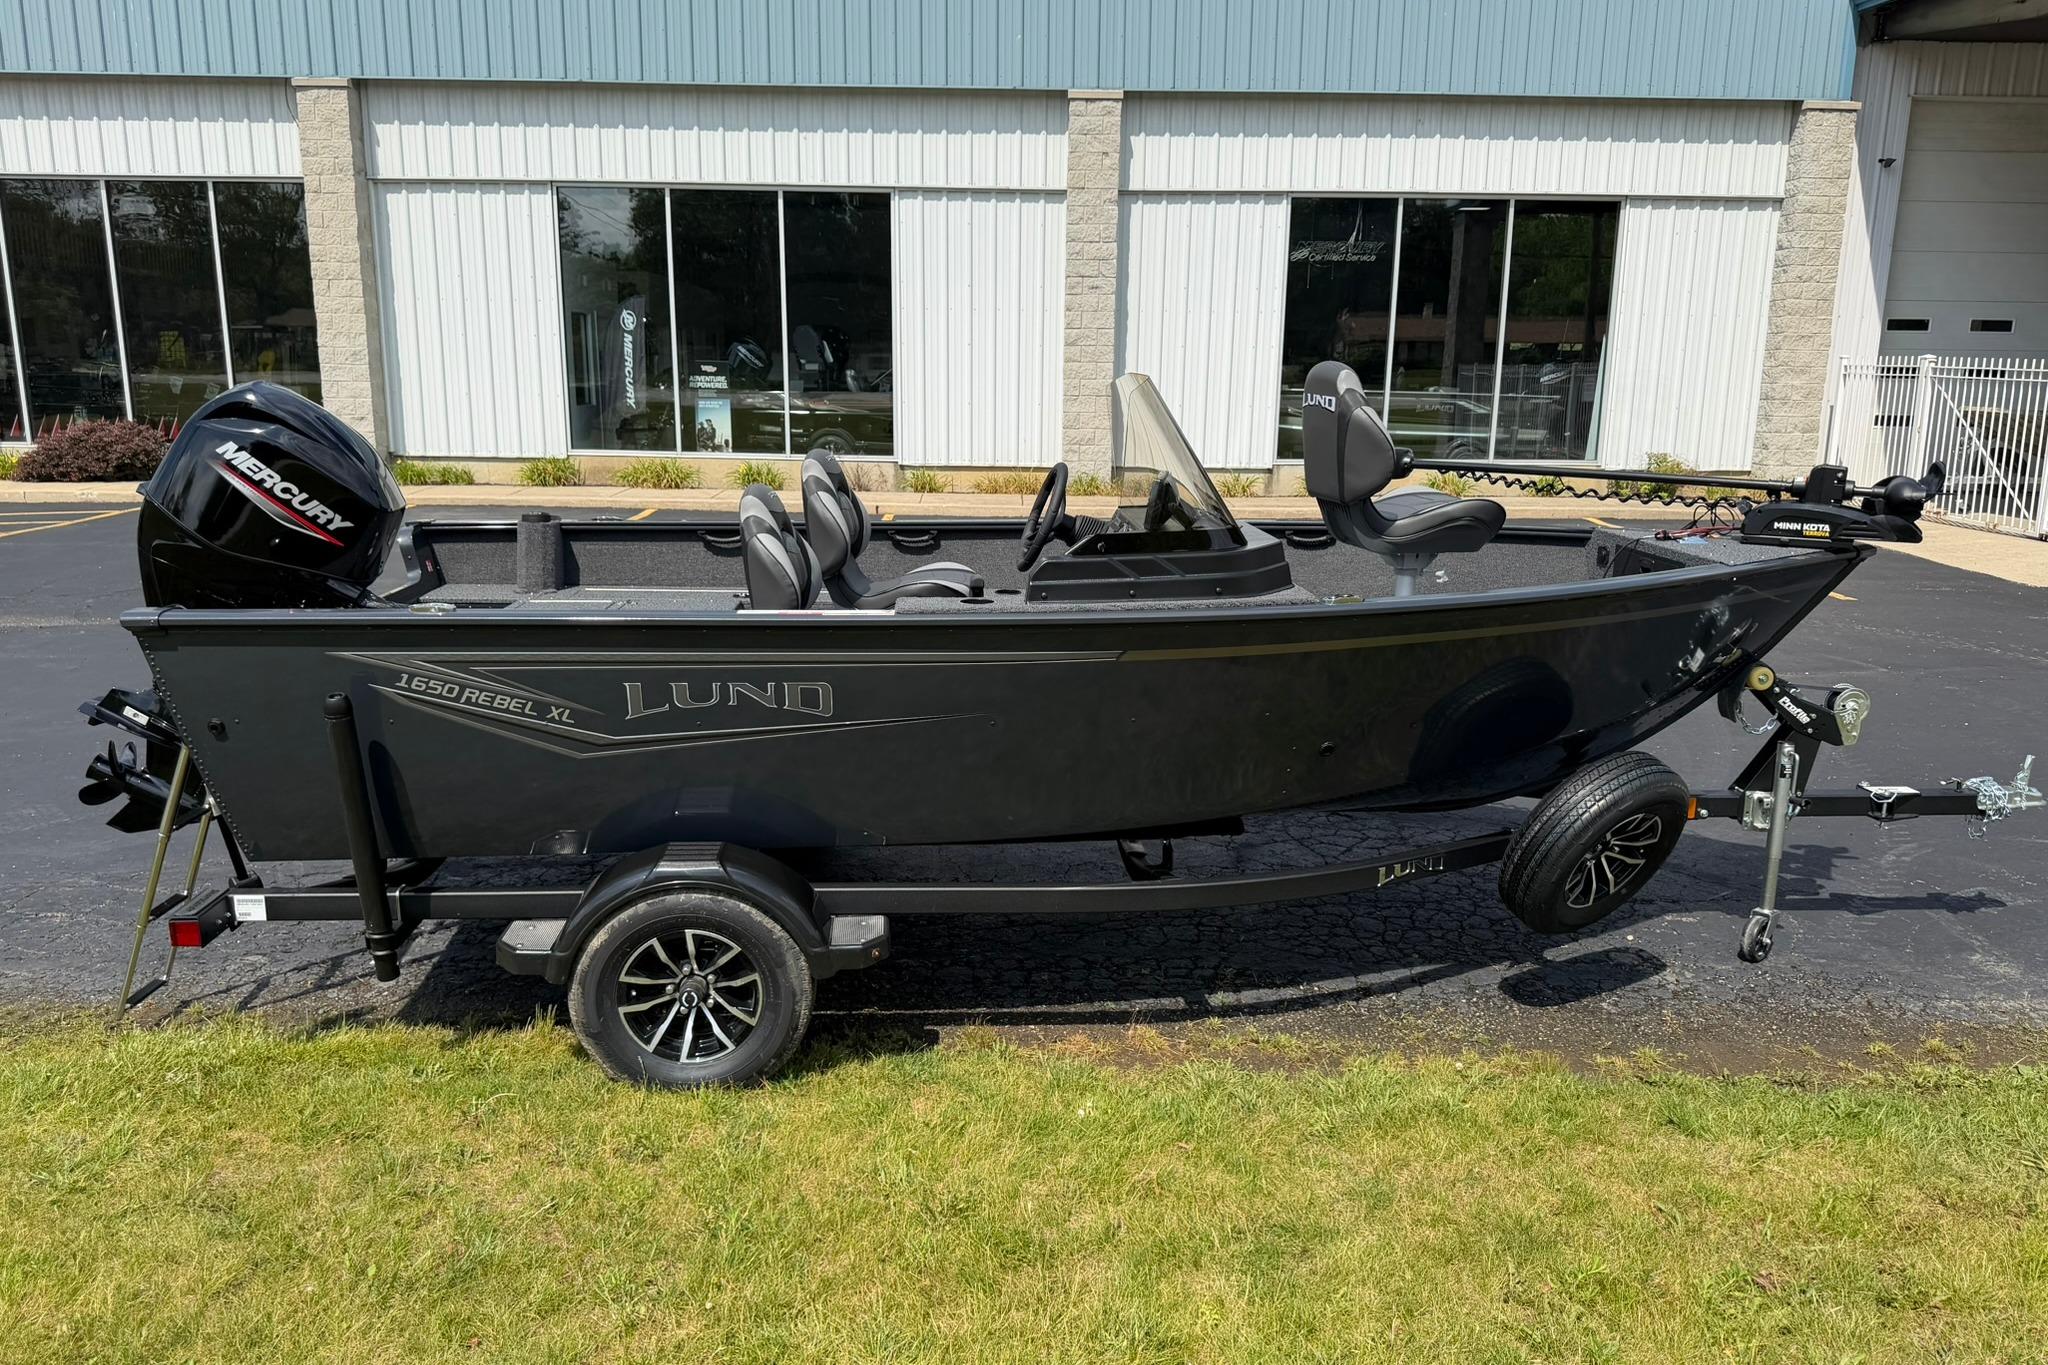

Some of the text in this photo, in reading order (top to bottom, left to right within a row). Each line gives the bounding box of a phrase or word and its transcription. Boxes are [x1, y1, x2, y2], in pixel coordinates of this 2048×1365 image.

[1308, 253, 1377, 261] Certified Service
[623, 332, 637, 409] MERCURY
[1302, 392, 1336, 413] LUND
[215, 441, 355, 531] MERCURY
[1773, 521, 1830, 531] MINN KOTA
[395, 673, 575, 723] 1650 REBEL XL
[623, 682, 833, 720] LUND
[1778, 695, 1811, 724] Profile
[1377, 856, 1444, 887] LUND
